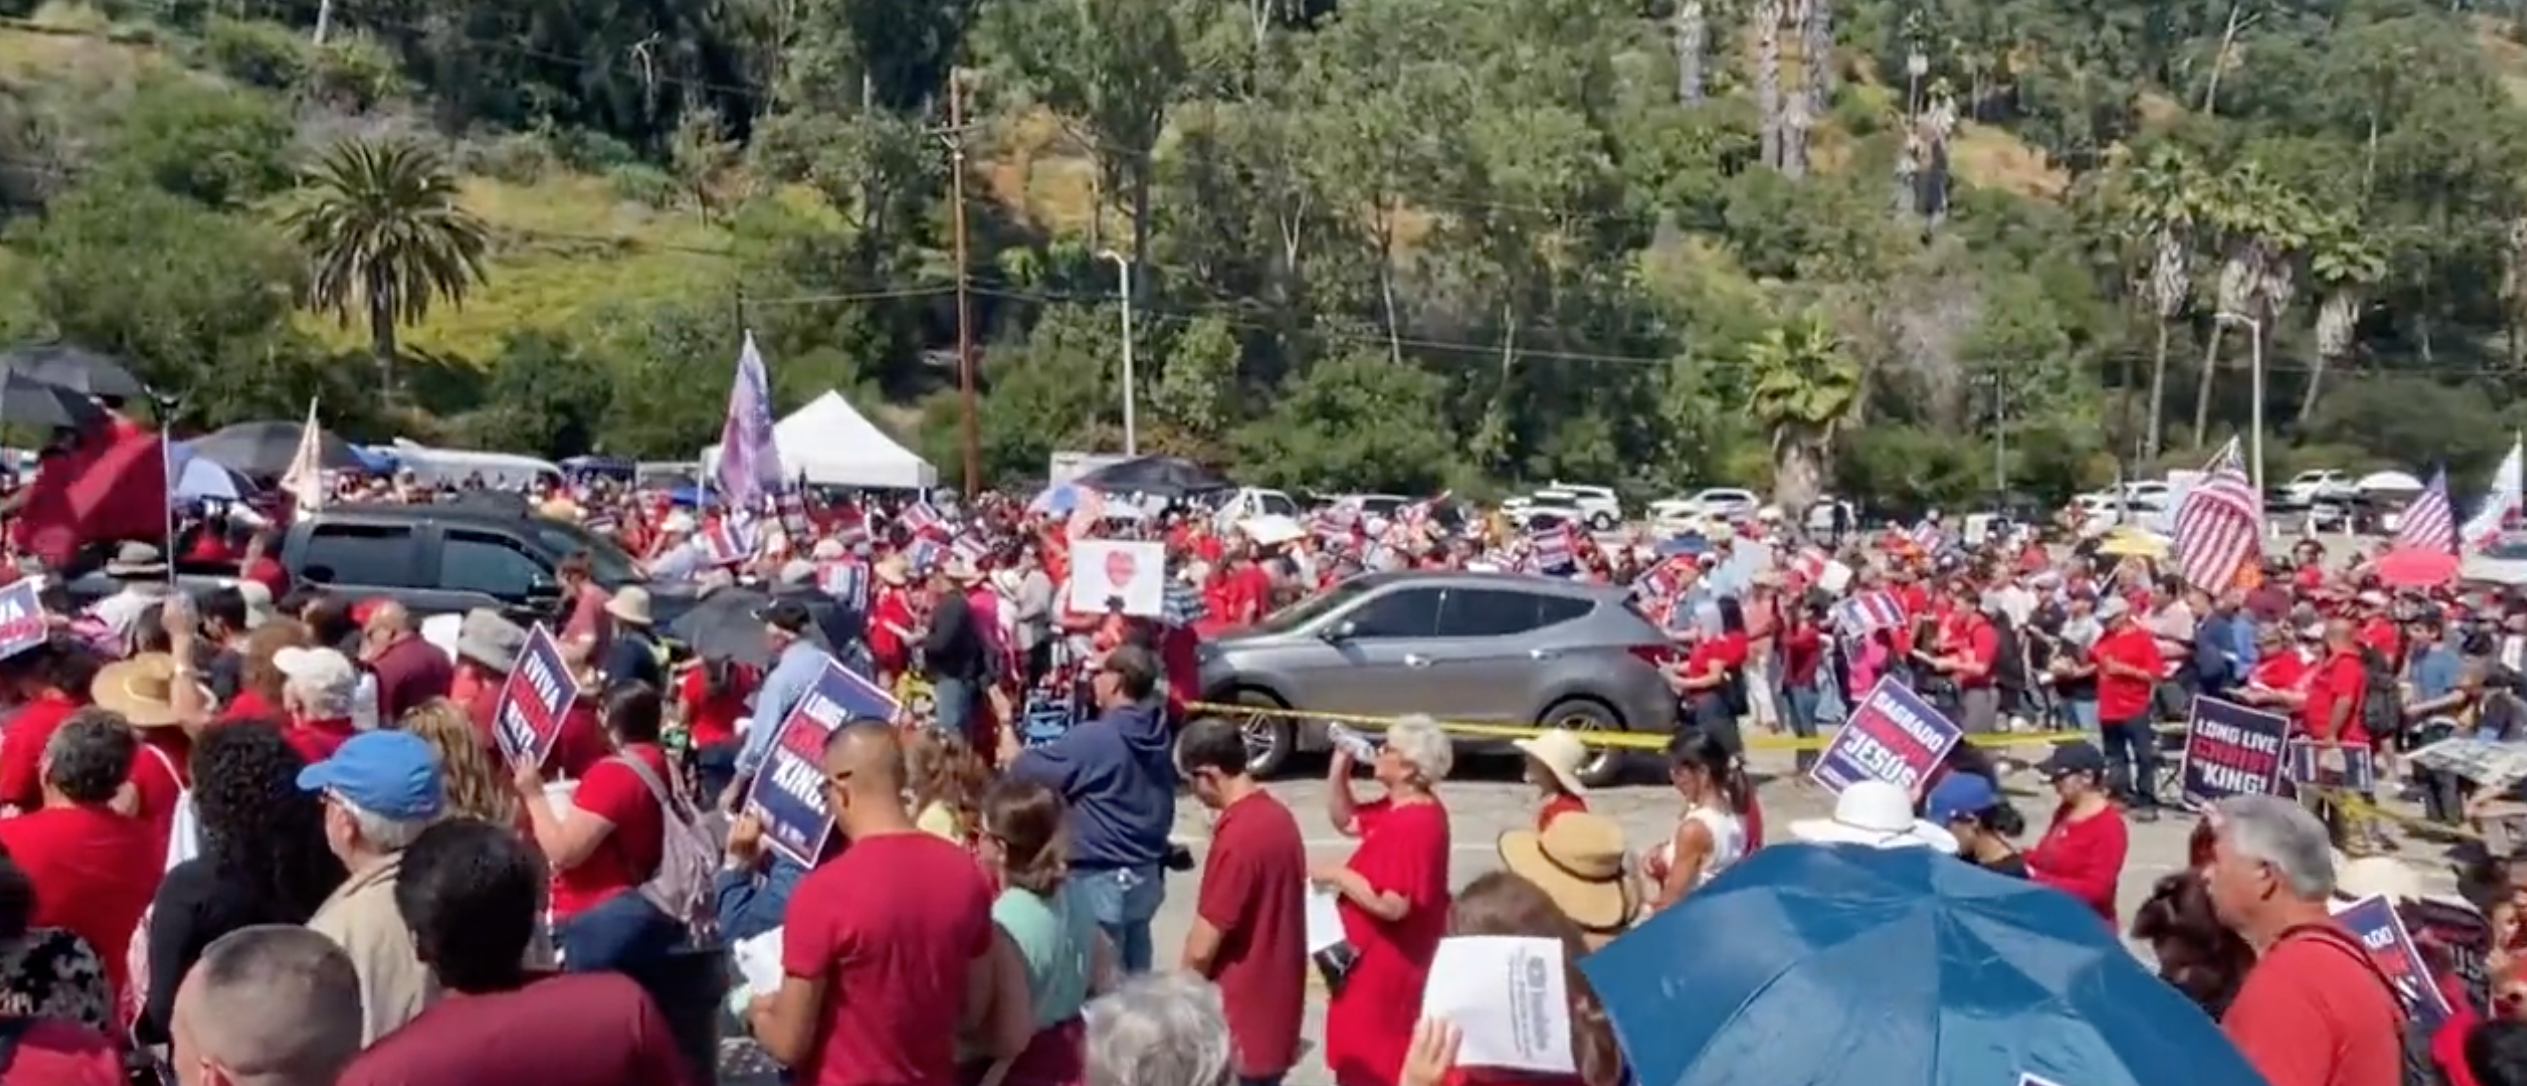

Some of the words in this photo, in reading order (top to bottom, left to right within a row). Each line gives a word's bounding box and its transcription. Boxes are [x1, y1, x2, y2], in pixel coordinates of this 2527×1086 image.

[803, 691, 848, 731] LONG
[1870, 690, 1946, 754] SAGRADO
[2195, 717, 2241, 745] LONG
[2241, 729, 2279, 756] LIVE
[2202, 760, 2268, 795] KING!
